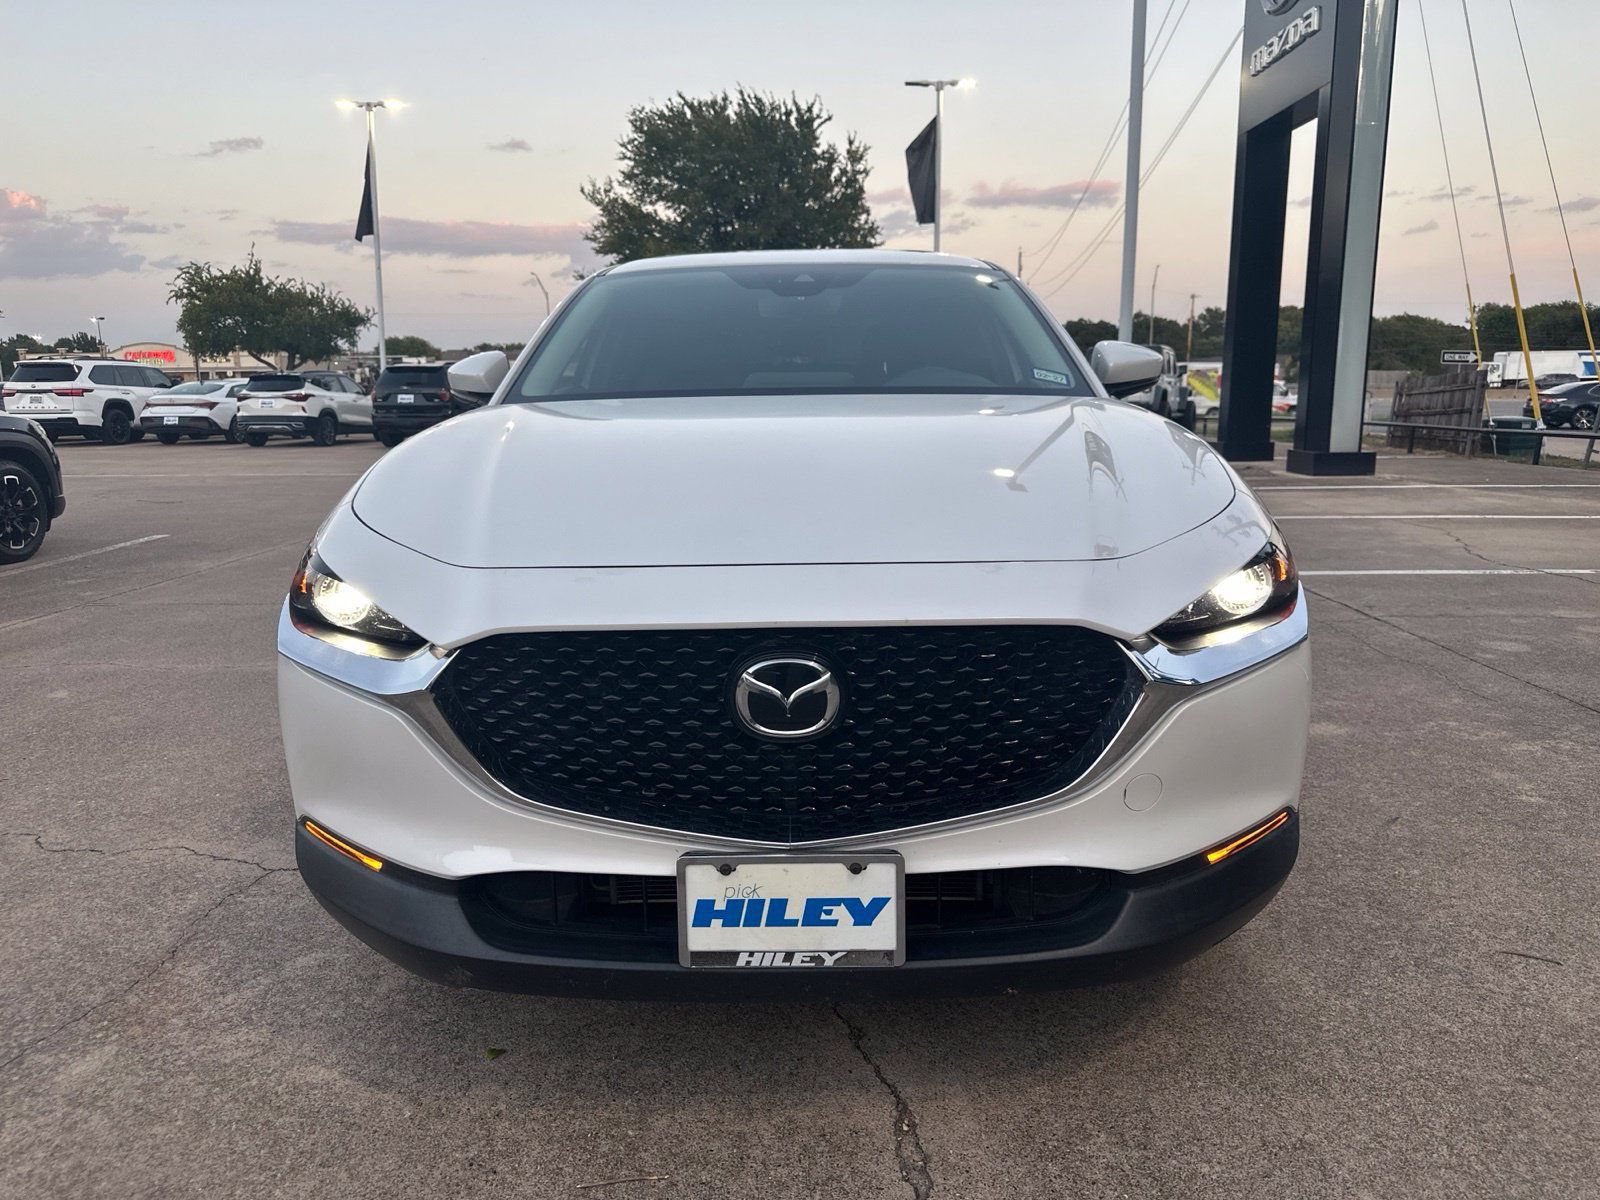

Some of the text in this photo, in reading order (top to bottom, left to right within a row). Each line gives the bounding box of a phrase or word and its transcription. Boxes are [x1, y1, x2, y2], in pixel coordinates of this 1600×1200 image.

[723, 883, 764, 901] pick
[691, 897, 892, 928] HILEY
[736, 951, 849, 967] HILEY
